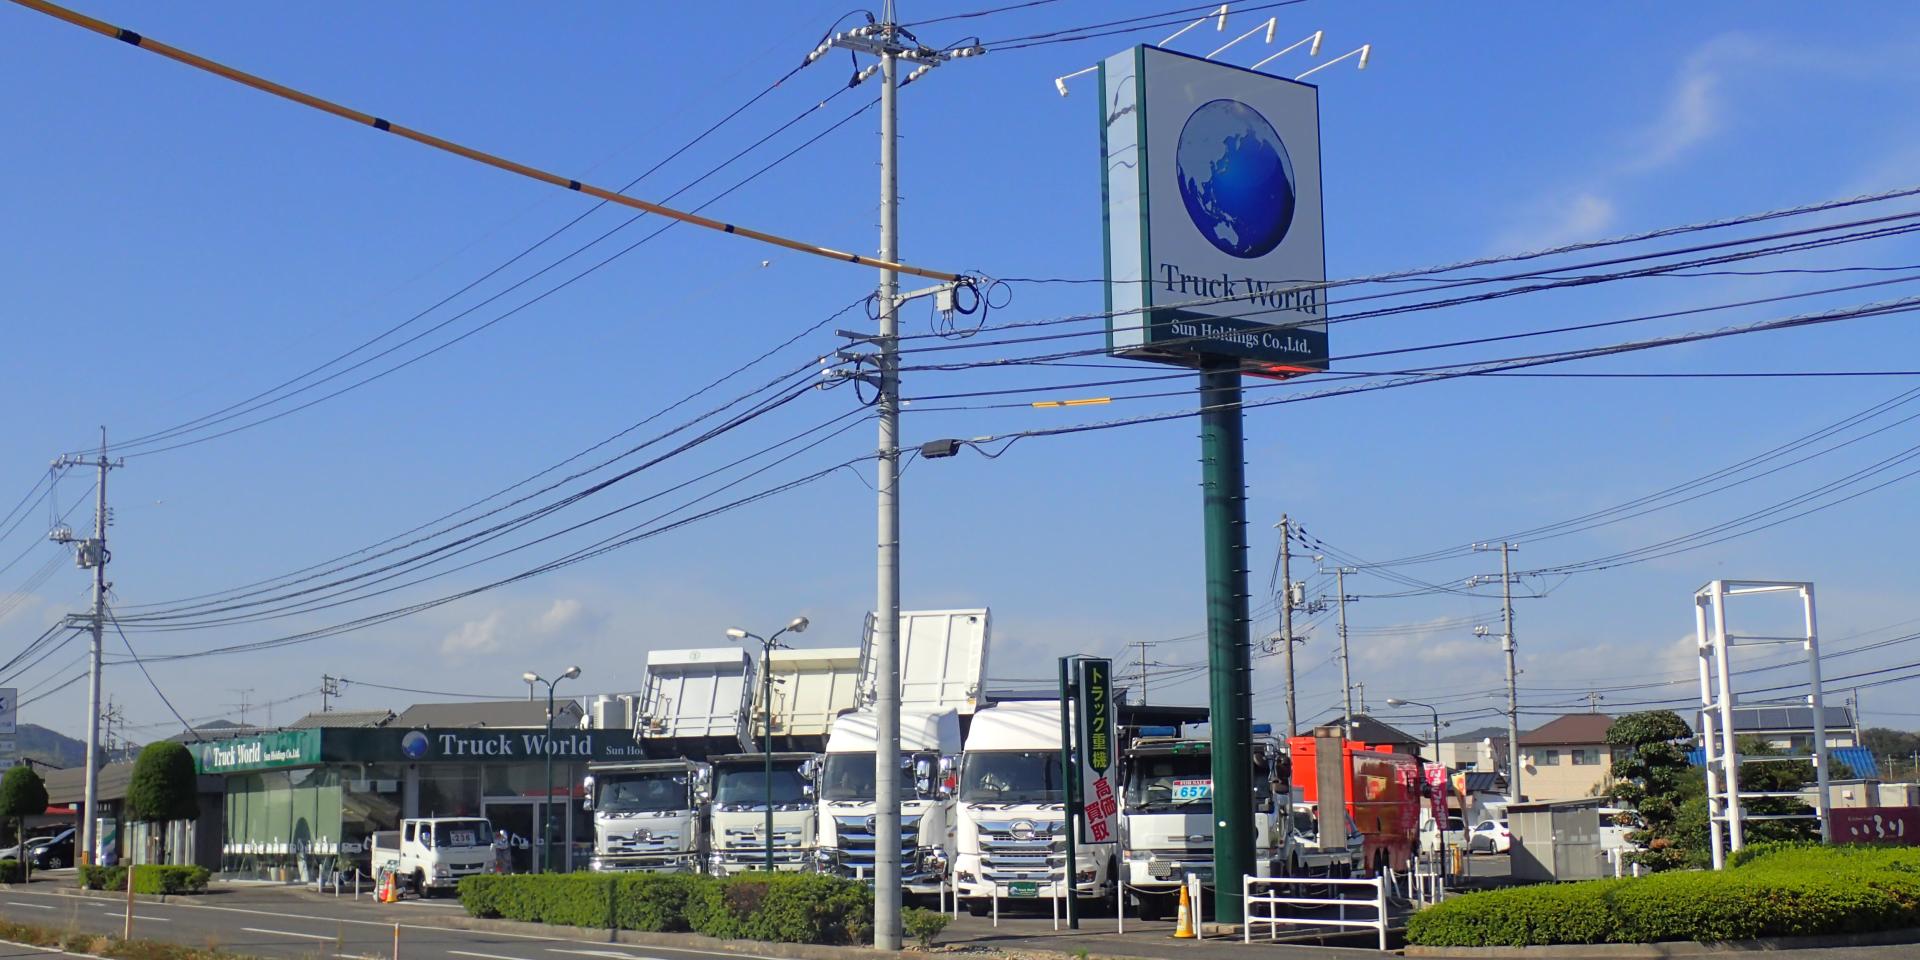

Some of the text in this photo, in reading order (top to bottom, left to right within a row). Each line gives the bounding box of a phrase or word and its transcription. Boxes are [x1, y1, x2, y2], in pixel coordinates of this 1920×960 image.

[1160, 263, 1317, 315] Truck World
[1171, 319, 1312, 354] Sun Holdings Co.,Ltd.
[1091, 667, 1108, 769] トラック重機
[214, 743, 260, 767] Truck World
[439, 734, 592, 756] Truck World
[606, 745, 624, 755] Sun
[1092, 776, 1117, 819] 高価
[1180, 786, 1208, 798] 657
[1085, 800, 1110, 842] 買取
[1851, 815, 1904, 838] いろり
